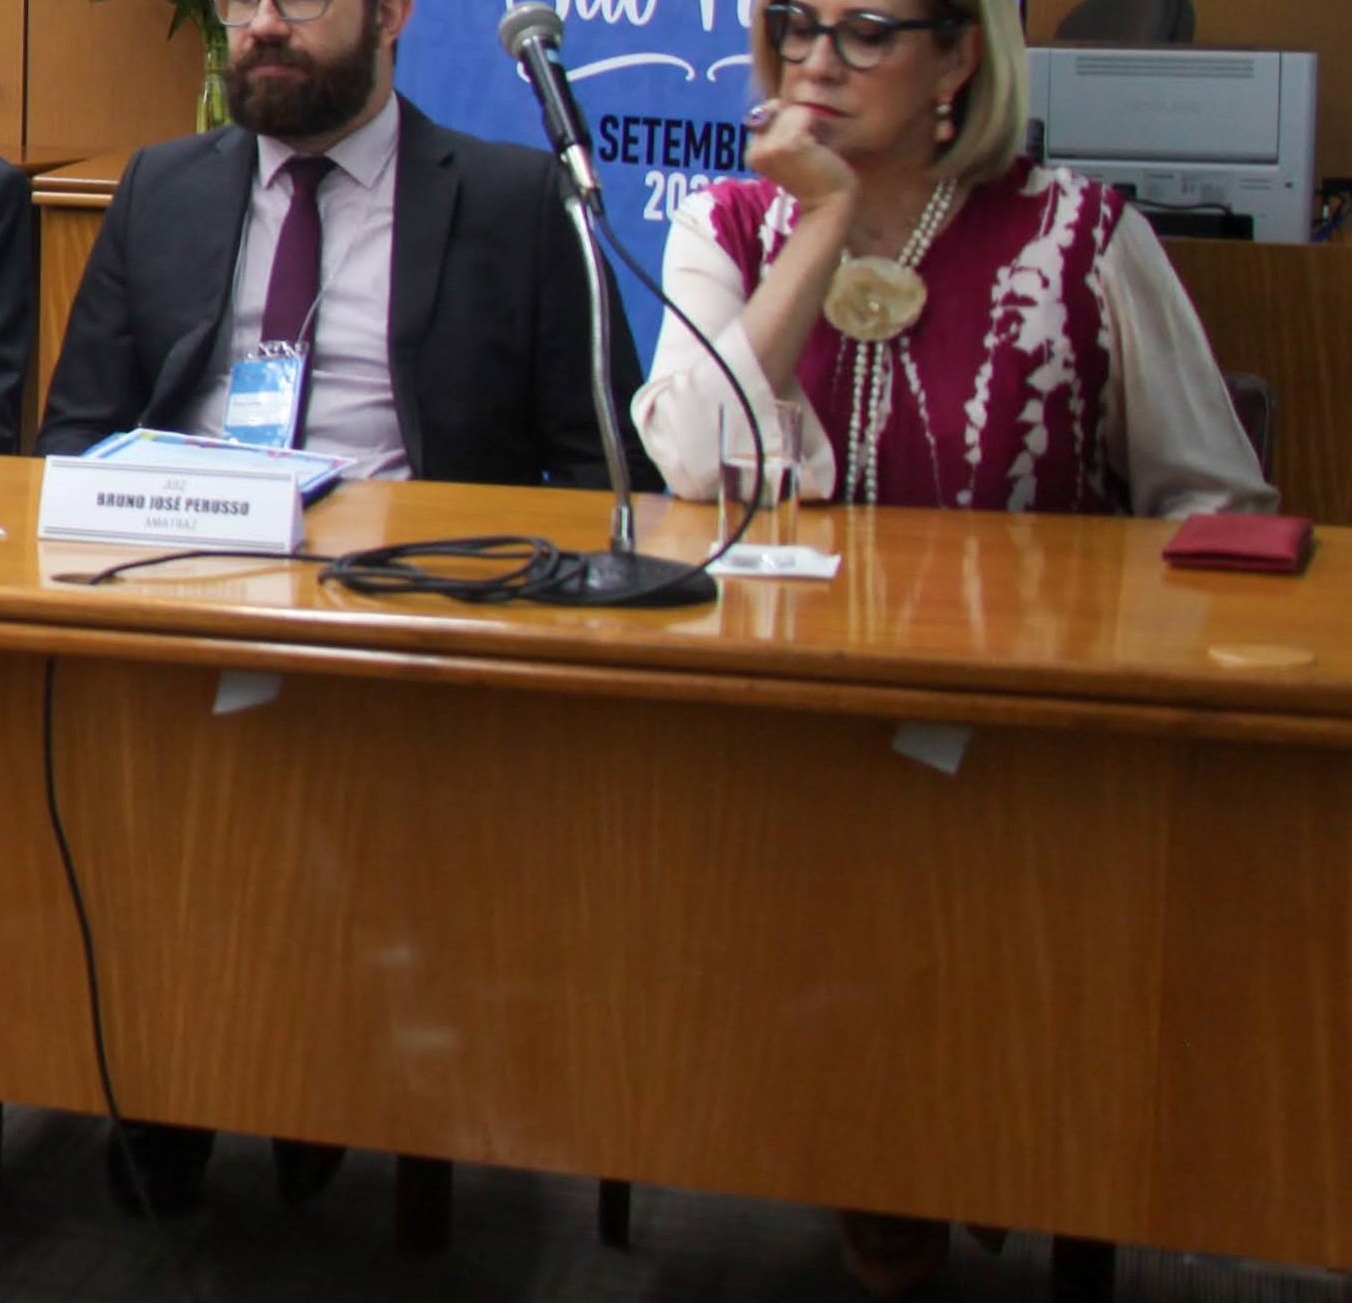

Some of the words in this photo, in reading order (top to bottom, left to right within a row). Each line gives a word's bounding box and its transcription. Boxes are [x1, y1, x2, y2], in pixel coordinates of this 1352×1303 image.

[599, 113, 750, 172] SETEMB
[96, 492, 145, 509] BRUNO
[148, 494, 181, 512] JOSÉ
[184, 498, 250, 516] PERUSSO
